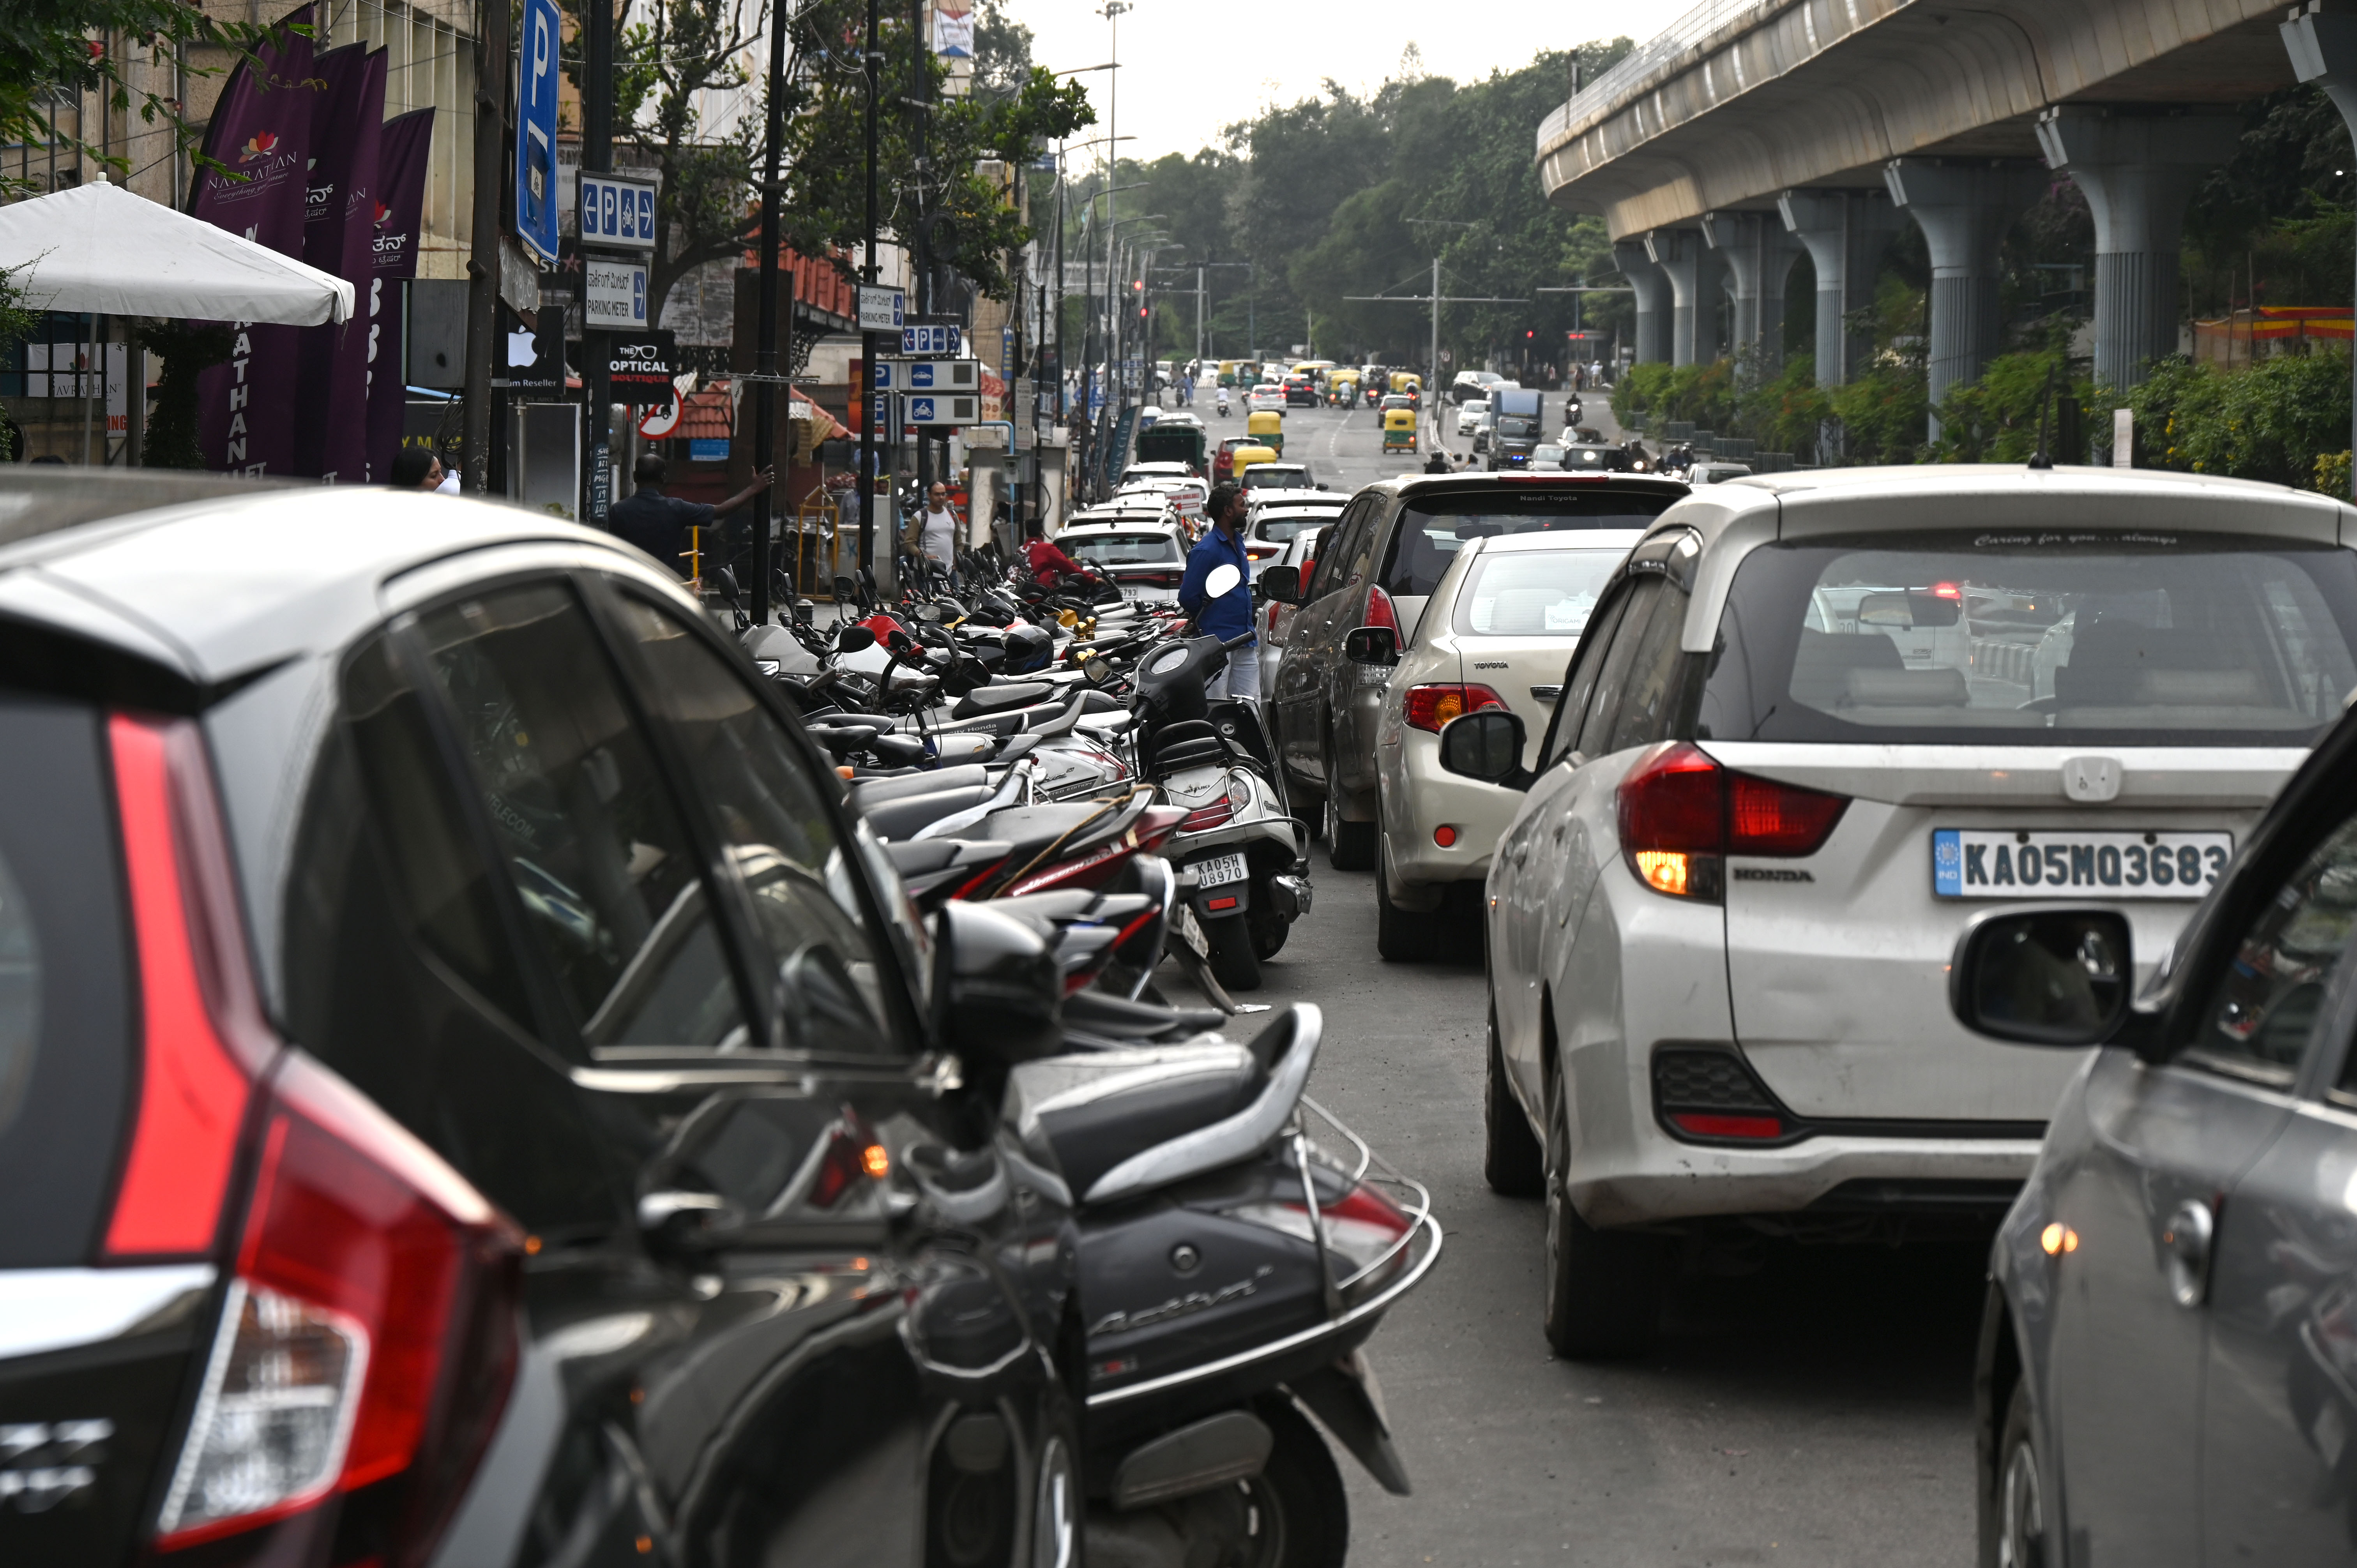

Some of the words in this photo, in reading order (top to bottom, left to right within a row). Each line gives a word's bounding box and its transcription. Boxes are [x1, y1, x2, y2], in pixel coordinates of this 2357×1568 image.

[532, 7, 549, 107] P
[207, 151, 297, 190] NAVRATAN
[214, 186, 256, 200] Everything
[605, 192, 614, 229] P
[588, 299, 611, 316] PARKING
[612, 301, 629, 317] METER
[860, 312, 878, 323] PARKING
[878, 314, 891, 324] METER
[610, 361, 669, 373] OPTICAL
[610, 374, 670, 383] BOUTIQUE
[2038, 533, 2062, 546] for
[1474, 661, 1509, 669] TOYOTA
[968, 724, 997, 732] Honda
[1039, 789, 1065, 800] LITED
[1067, 781, 1092, 791] EDITION
[1197, 855, 1239, 875] KA05H
[1965, 844, 2228, 886] KA05MQ3683
[1200, 867, 1242, 886] U8970
[1734, 868, 1816, 883] HONDA
[1938, 871, 1958, 880] IND
